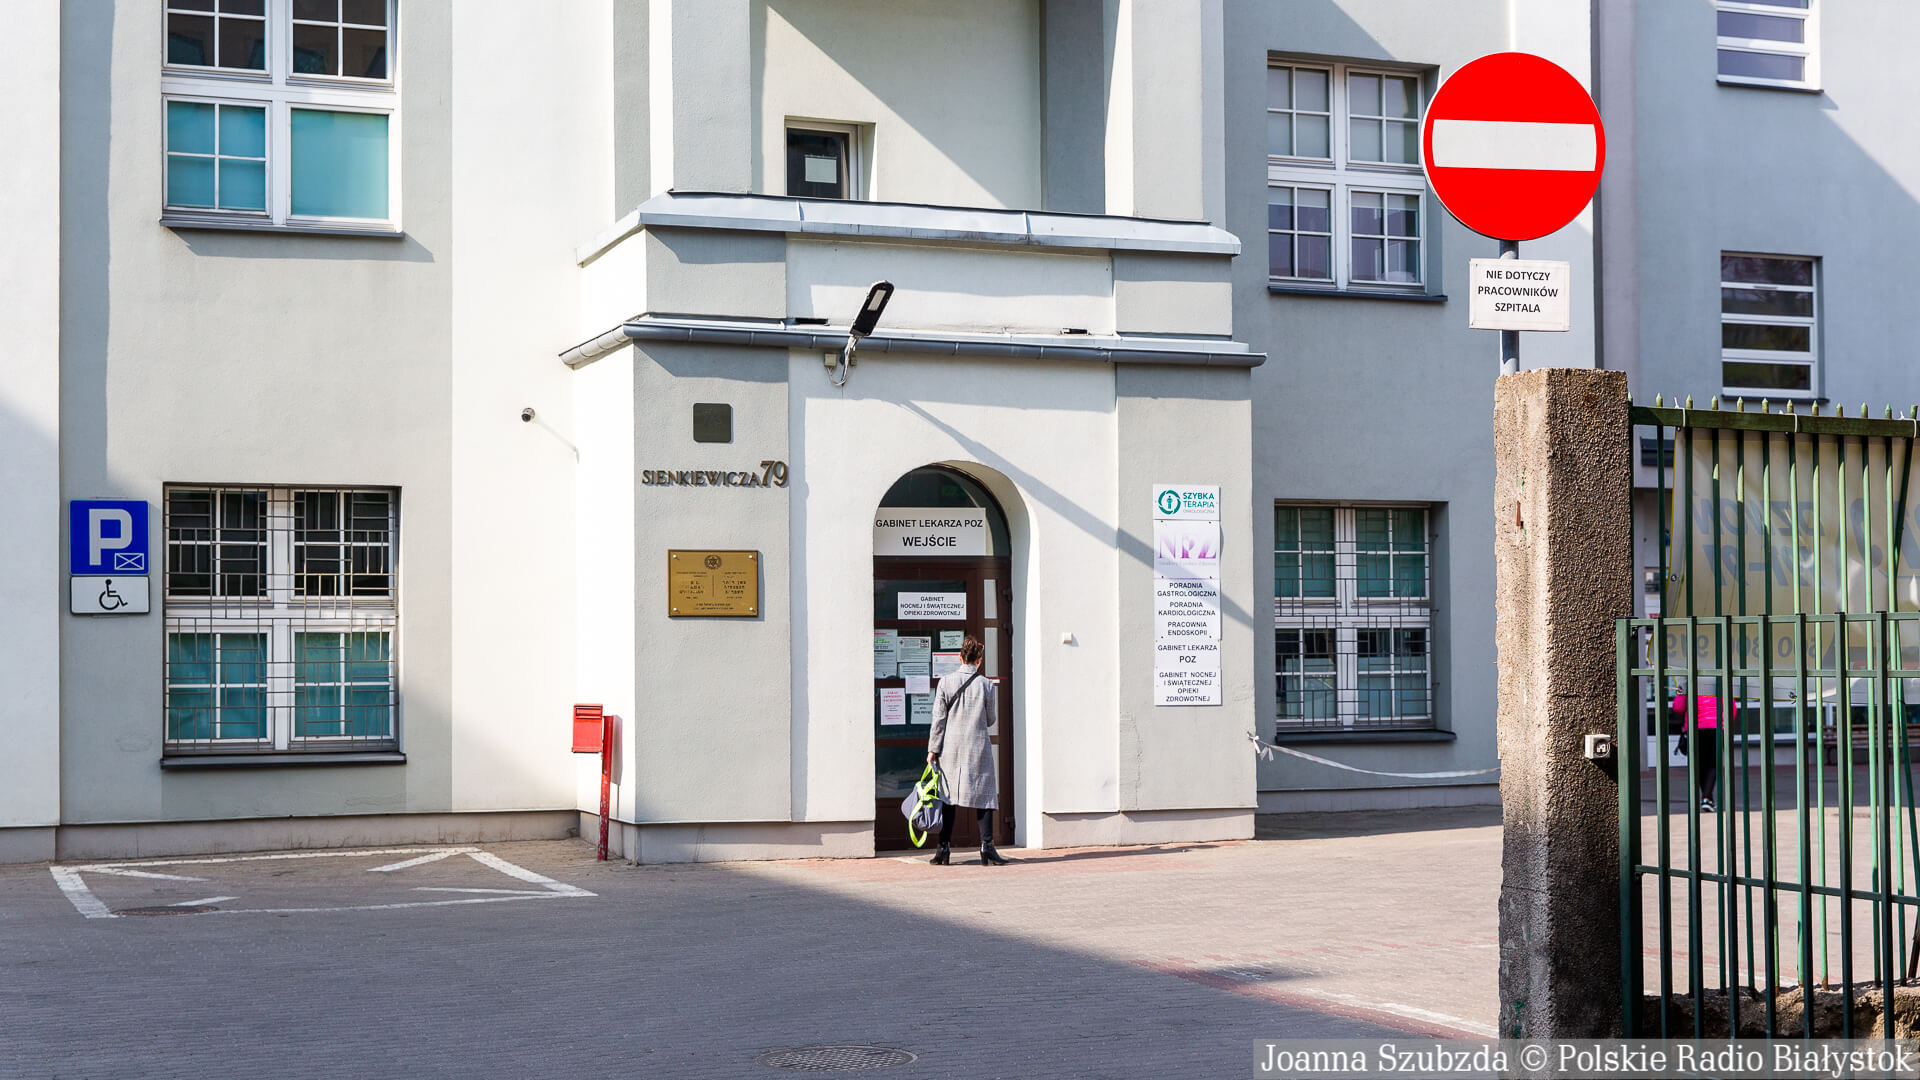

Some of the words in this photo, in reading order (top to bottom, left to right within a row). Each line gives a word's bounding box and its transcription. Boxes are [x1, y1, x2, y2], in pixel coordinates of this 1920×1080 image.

[1486, 270, 1503, 279] NIE
[1505, 271, 1551, 281] DOTYCZY
[1478, 286, 1559, 297] PRACOWNIKÓW
[1495, 302, 1540, 312] SZPITALA
[642, 469, 760, 487] SIENKIEWICZA
[760, 460, 788, 487] 79
[1182, 492, 1215, 500] SZYBKA
[1183, 500, 1215, 508] TERAPIA
[875, 519, 917, 528] GABINET
[919, 519, 963, 528] LEKARZA
[964, 519, 983, 528] POZ
[88, 508, 133, 566] P
[902, 534, 957, 547] WEJŚCIE
